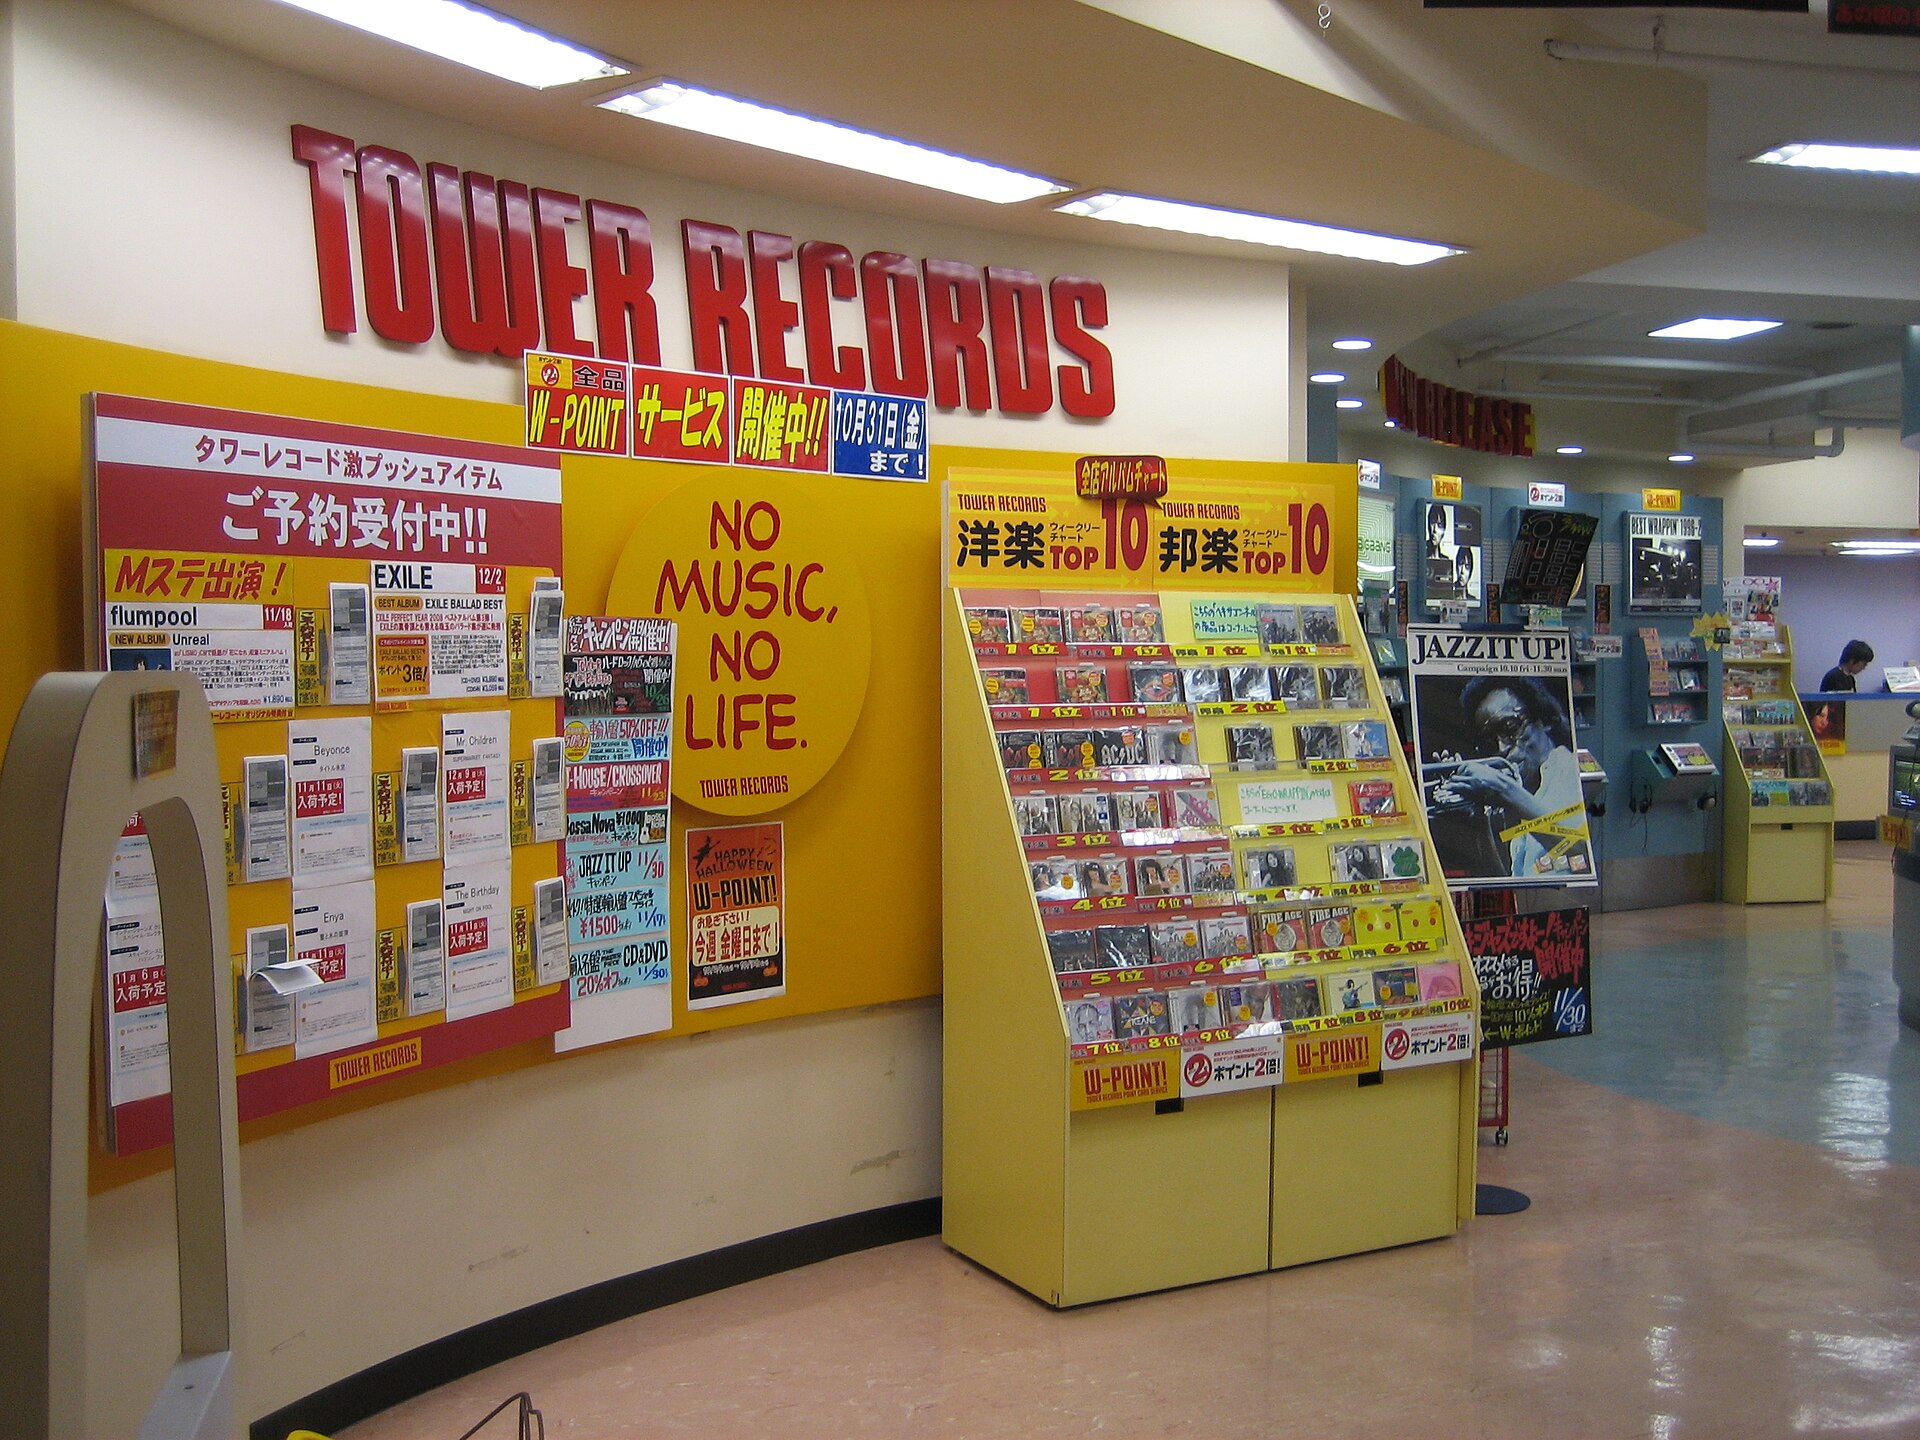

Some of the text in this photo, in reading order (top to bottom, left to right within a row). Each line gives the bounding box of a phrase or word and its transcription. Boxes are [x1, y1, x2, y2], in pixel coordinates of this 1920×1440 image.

[292, 124, 1115, 418] TOWER RECORDS
[574, 365, 625, 391] 全品
[529, 389, 624, 451] W-POINT
[637, 384, 724, 449] サービス
[736, 387, 828, 463] 開催中!!
[836, 397, 925, 452] 10月31日(金)
[195, 434, 503, 492] タワーレコード激プッシュアイテム
[1080, 459, 1165, 496] 全店アルバムチャート
[957, 493, 1046, 513] TOWER RECORDS
[1162, 501, 1240, 520] TOWER RECORDS
[222, 486, 488, 555] ご予約受付中!!
[710, 500, 781, 552] NO
[1632, 516, 1646, 534] BEST
[956, 497, 1148, 571] 洋楽 ウィークリー 10
[1050, 533, 1085, 543] チャート
[1159, 502, 1329, 576] 邦楽 ウィークリー 10
[1242, 538, 1274, 549] チャート
[1050, 546, 1099, 570] TOP
[1242, 550, 1286, 575] TOP
[114, 555, 286, 600] Mステ出演!
[375, 564, 502, 589] EXILE 12/2
[656, 559, 838, 624] MUSIC,
[378, 599, 503, 610] BEST ALBUM EXILE BALLAD BEST
[111, 605, 293, 630] flumpool 11/18
[115, 633, 209, 646] NEW ALBUM Unreal
[1411, 634, 1568, 665] JAZZ IT UP!
[709, 630, 780, 683] NO
[1457, 663, 1499, 675] Campaign
[378, 664, 427, 683] ポイント 3倍!
[684, 693, 808, 752] LIFE.
[313, 744, 351, 760] Beyonce
[468, 735, 498, 747] Children
[447, 780, 485, 797] 入荷予定!
[699, 774, 789, 804] TOWER RECORDS
[297, 793, 342, 811] 入荷予定!
[567, 814, 592, 836] ossa
[592, 811, 616, 834] Nova
[579, 852, 603, 879] JAZZ
[604, 851, 617, 873] IT
[618, 849, 632, 873] UP
[714, 847, 755, 862] HAPPY
[696, 858, 774, 880] HALLOWEEN
[455, 884, 500, 900] The Birthday
[692, 874, 779, 912] W-POINT!
[323, 911, 344, 925] Enya
[579, 914, 619, 939] ¥1500
[696, 910, 750, 930] お急ぎ下さい!
[1262, 908, 1303, 929] FIRE AGE
[1310, 905, 1350, 925] FIRE AGE
[449, 932, 486, 950] 入荷予定!
[695, 921, 779, 965] 今週 金曜日まで!
[622, 939, 668, 969] CD&DVD
[114, 980, 167, 1004] 入荷予定
[576, 967, 620, 998] 20%オフ
[1553, 986, 1587, 1032] 11/30
[1295, 1036, 1370, 1068] W-POINT!
[1410, 1032, 1471, 1056] ポイント2倍!
[334, 1043, 419, 1083] TOWER RECORDS
[1214, 1056, 1281, 1082] ポイント2倍!
[1083, 1060, 1167, 1096] W-POINT!
